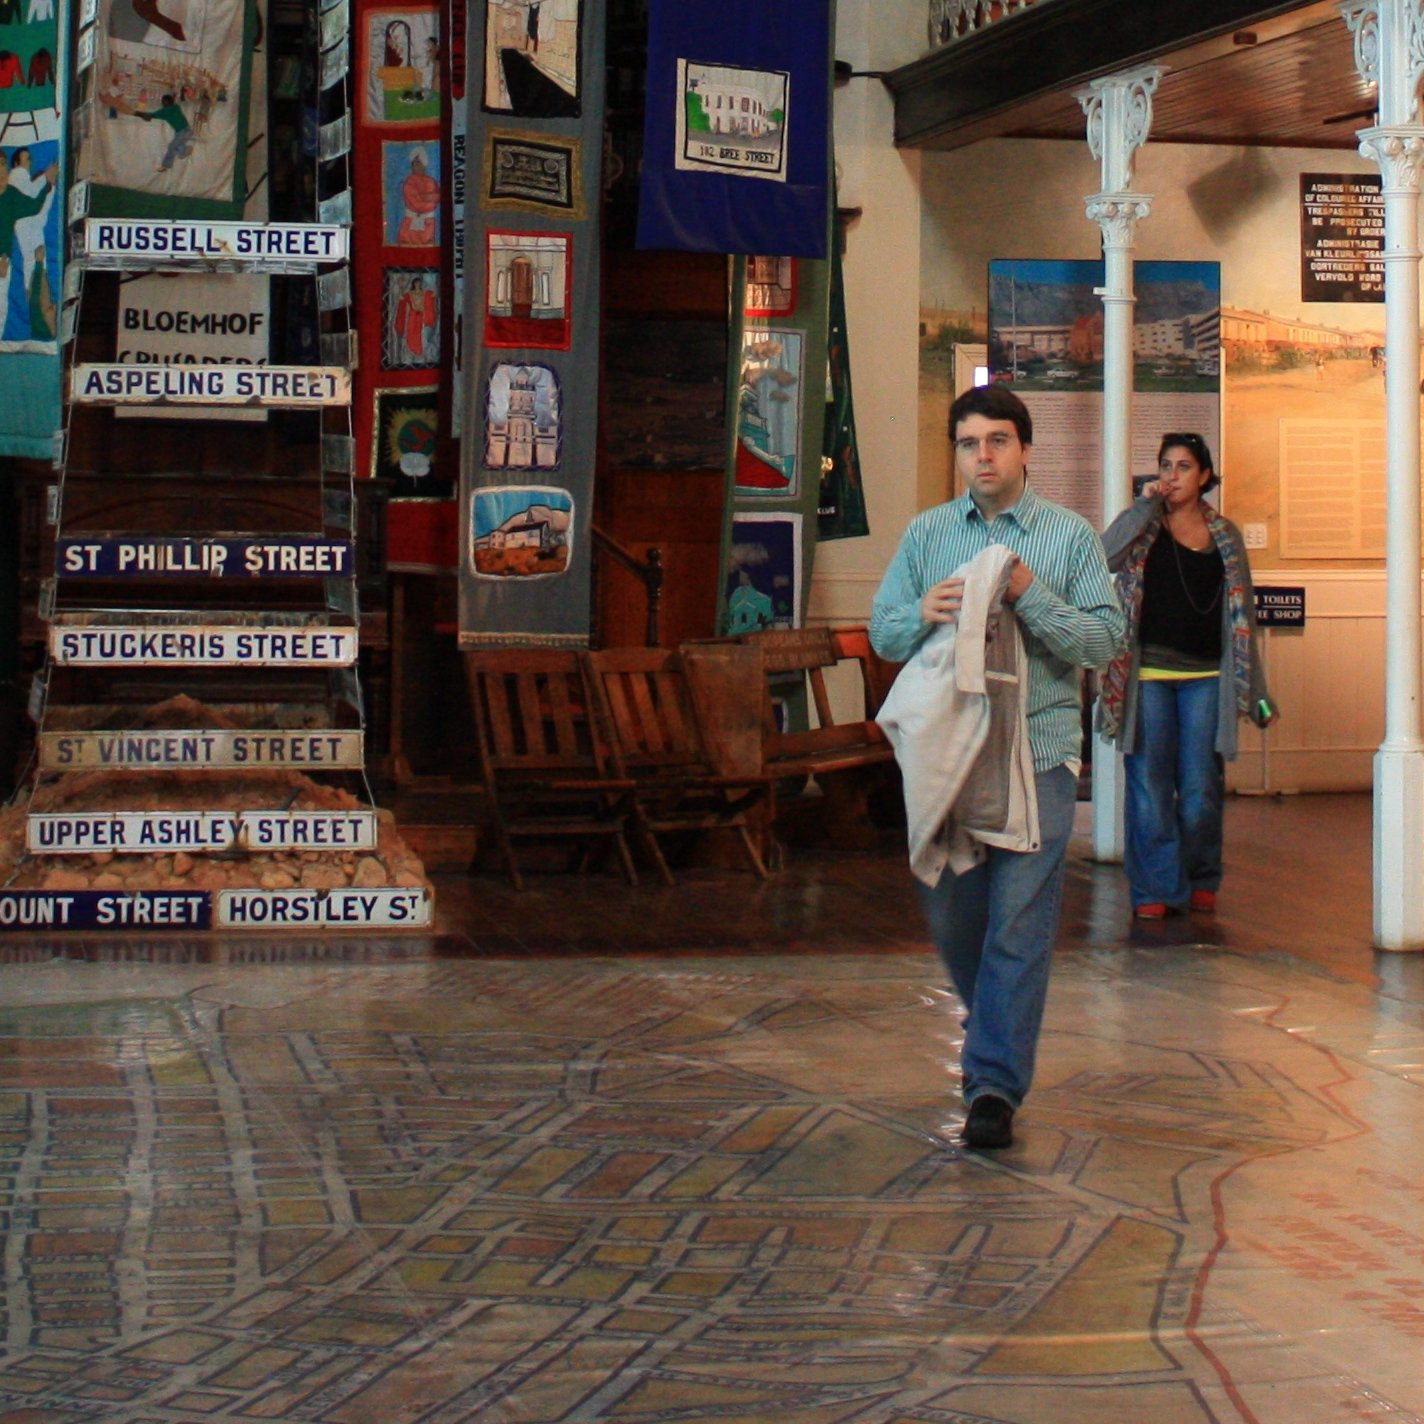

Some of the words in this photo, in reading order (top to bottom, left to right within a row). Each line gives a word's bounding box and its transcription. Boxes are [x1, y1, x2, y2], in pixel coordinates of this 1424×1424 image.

[746, 151, 774, 164] STREET
[1311, 217, 1323, 226] BE
[98, 226, 221, 252] RUSSELL
[237, 229, 336, 255] STREET
[124, 308, 264, 335] BLOEMHOF
[85, 371, 224, 395] ASPELING
[236, 372, 336, 397] STREET
[65, 545, 101, 570] ST
[119, 545, 227, 571] PHILLIP
[245, 546, 347, 571] STREET
[1263, 595, 1302, 604] TOILETS
[1273, 610, 1302, 619] SHOP
[63, 633, 225, 659] STUCKERIS
[236, 634, 345, 659] STREET
[98, 737, 215, 762] VINCENT
[233, 737, 342, 761] STREET
[39, 820, 126, 846] UPPER
[139, 819, 247, 845] ASHLEY
[259, 818, 363, 843] STREET
[97, 896, 202, 923] STREET
[229, 895, 378, 922] HORSTLEY
